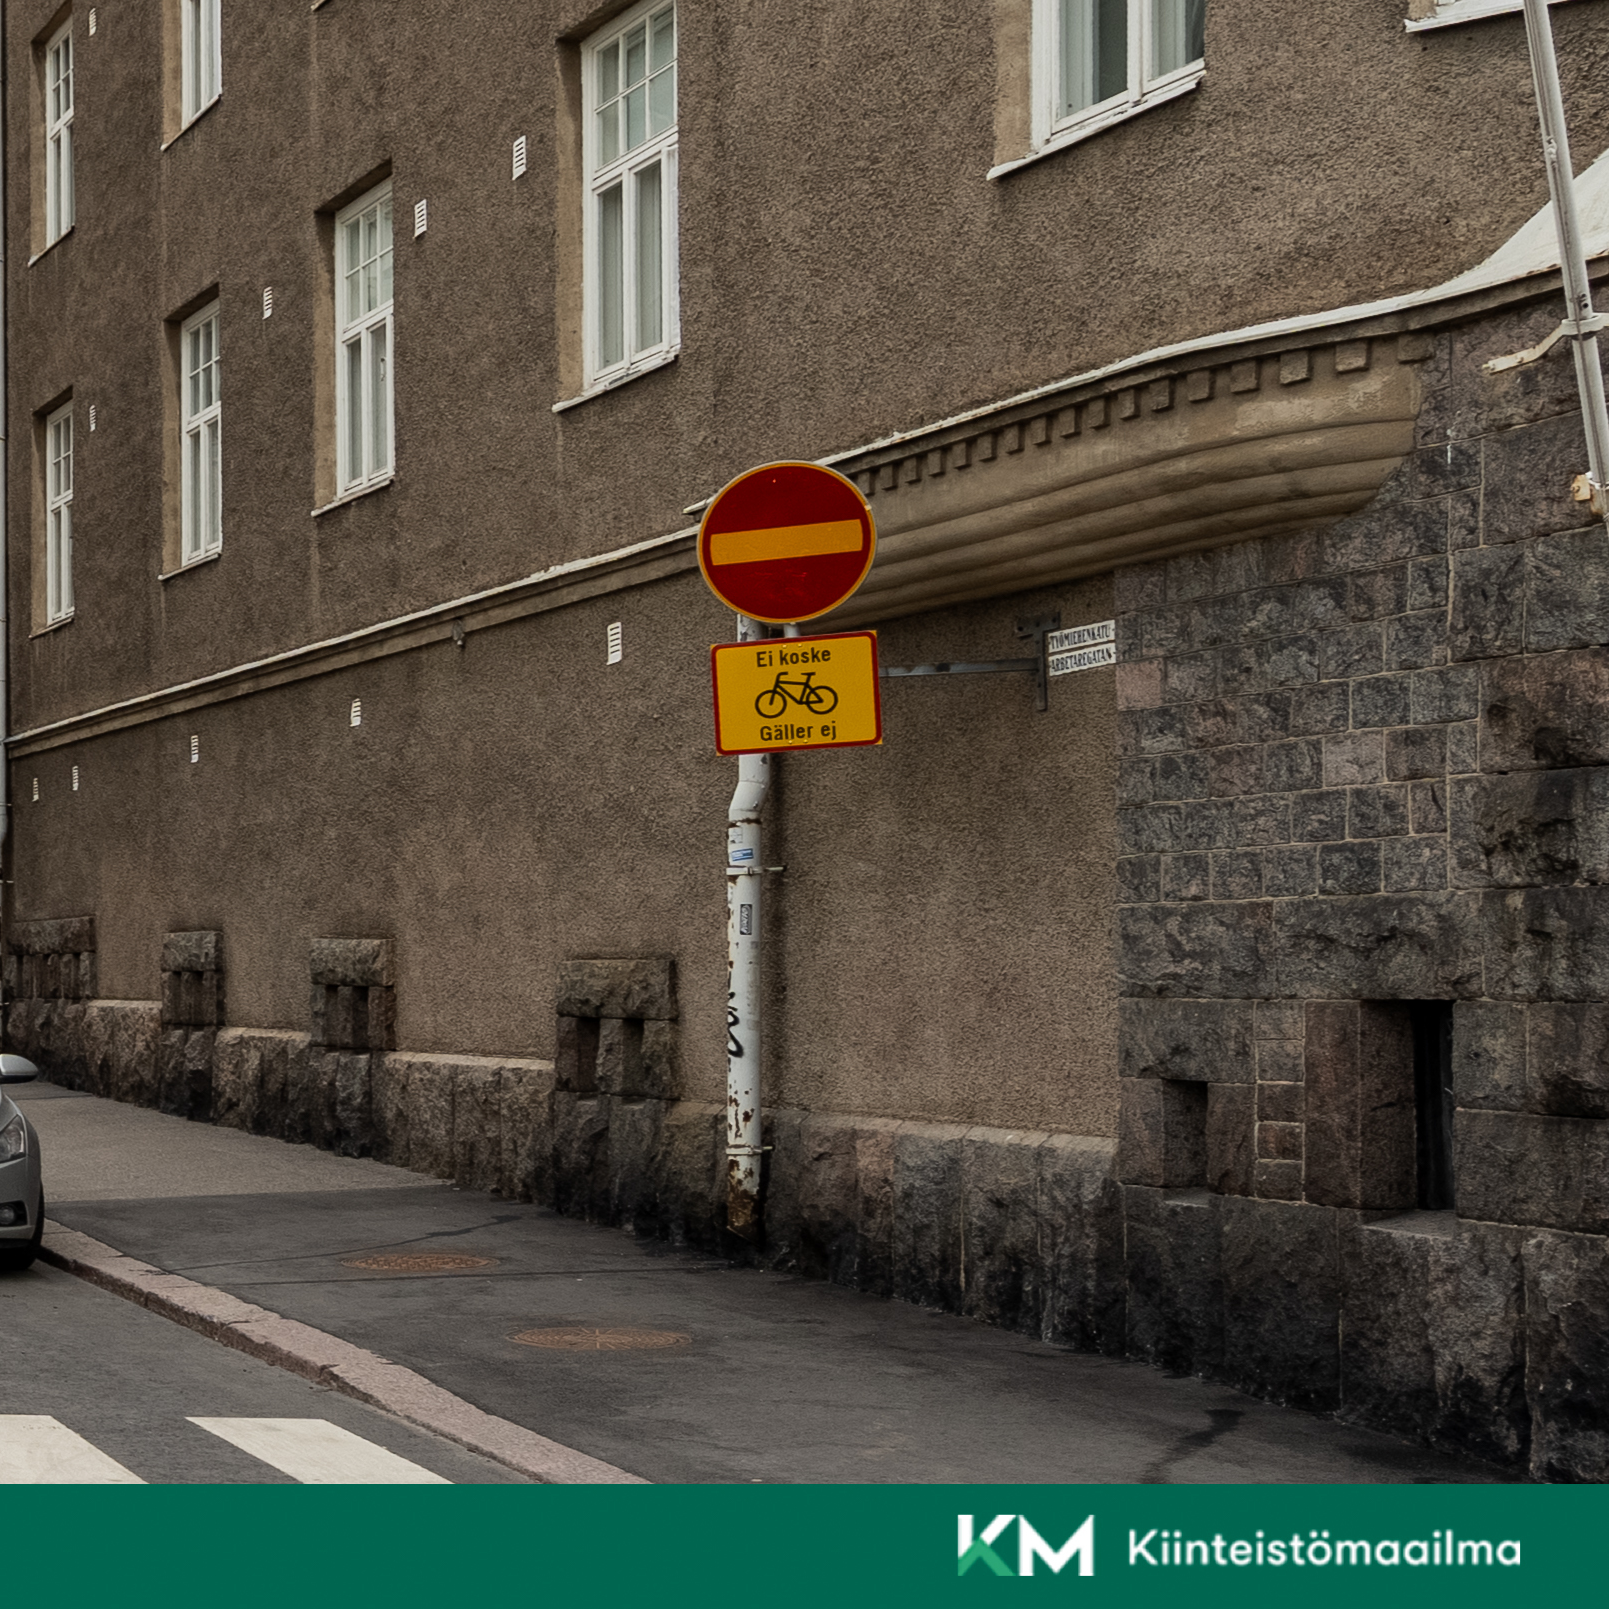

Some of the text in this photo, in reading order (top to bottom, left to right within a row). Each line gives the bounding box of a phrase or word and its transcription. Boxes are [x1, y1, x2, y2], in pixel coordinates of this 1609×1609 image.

[1049, 624, 1110, 650] TYÖMIEHENKATU
[756, 647, 831, 668] Ei koske
[760, 720, 836, 741] Gäller ej
